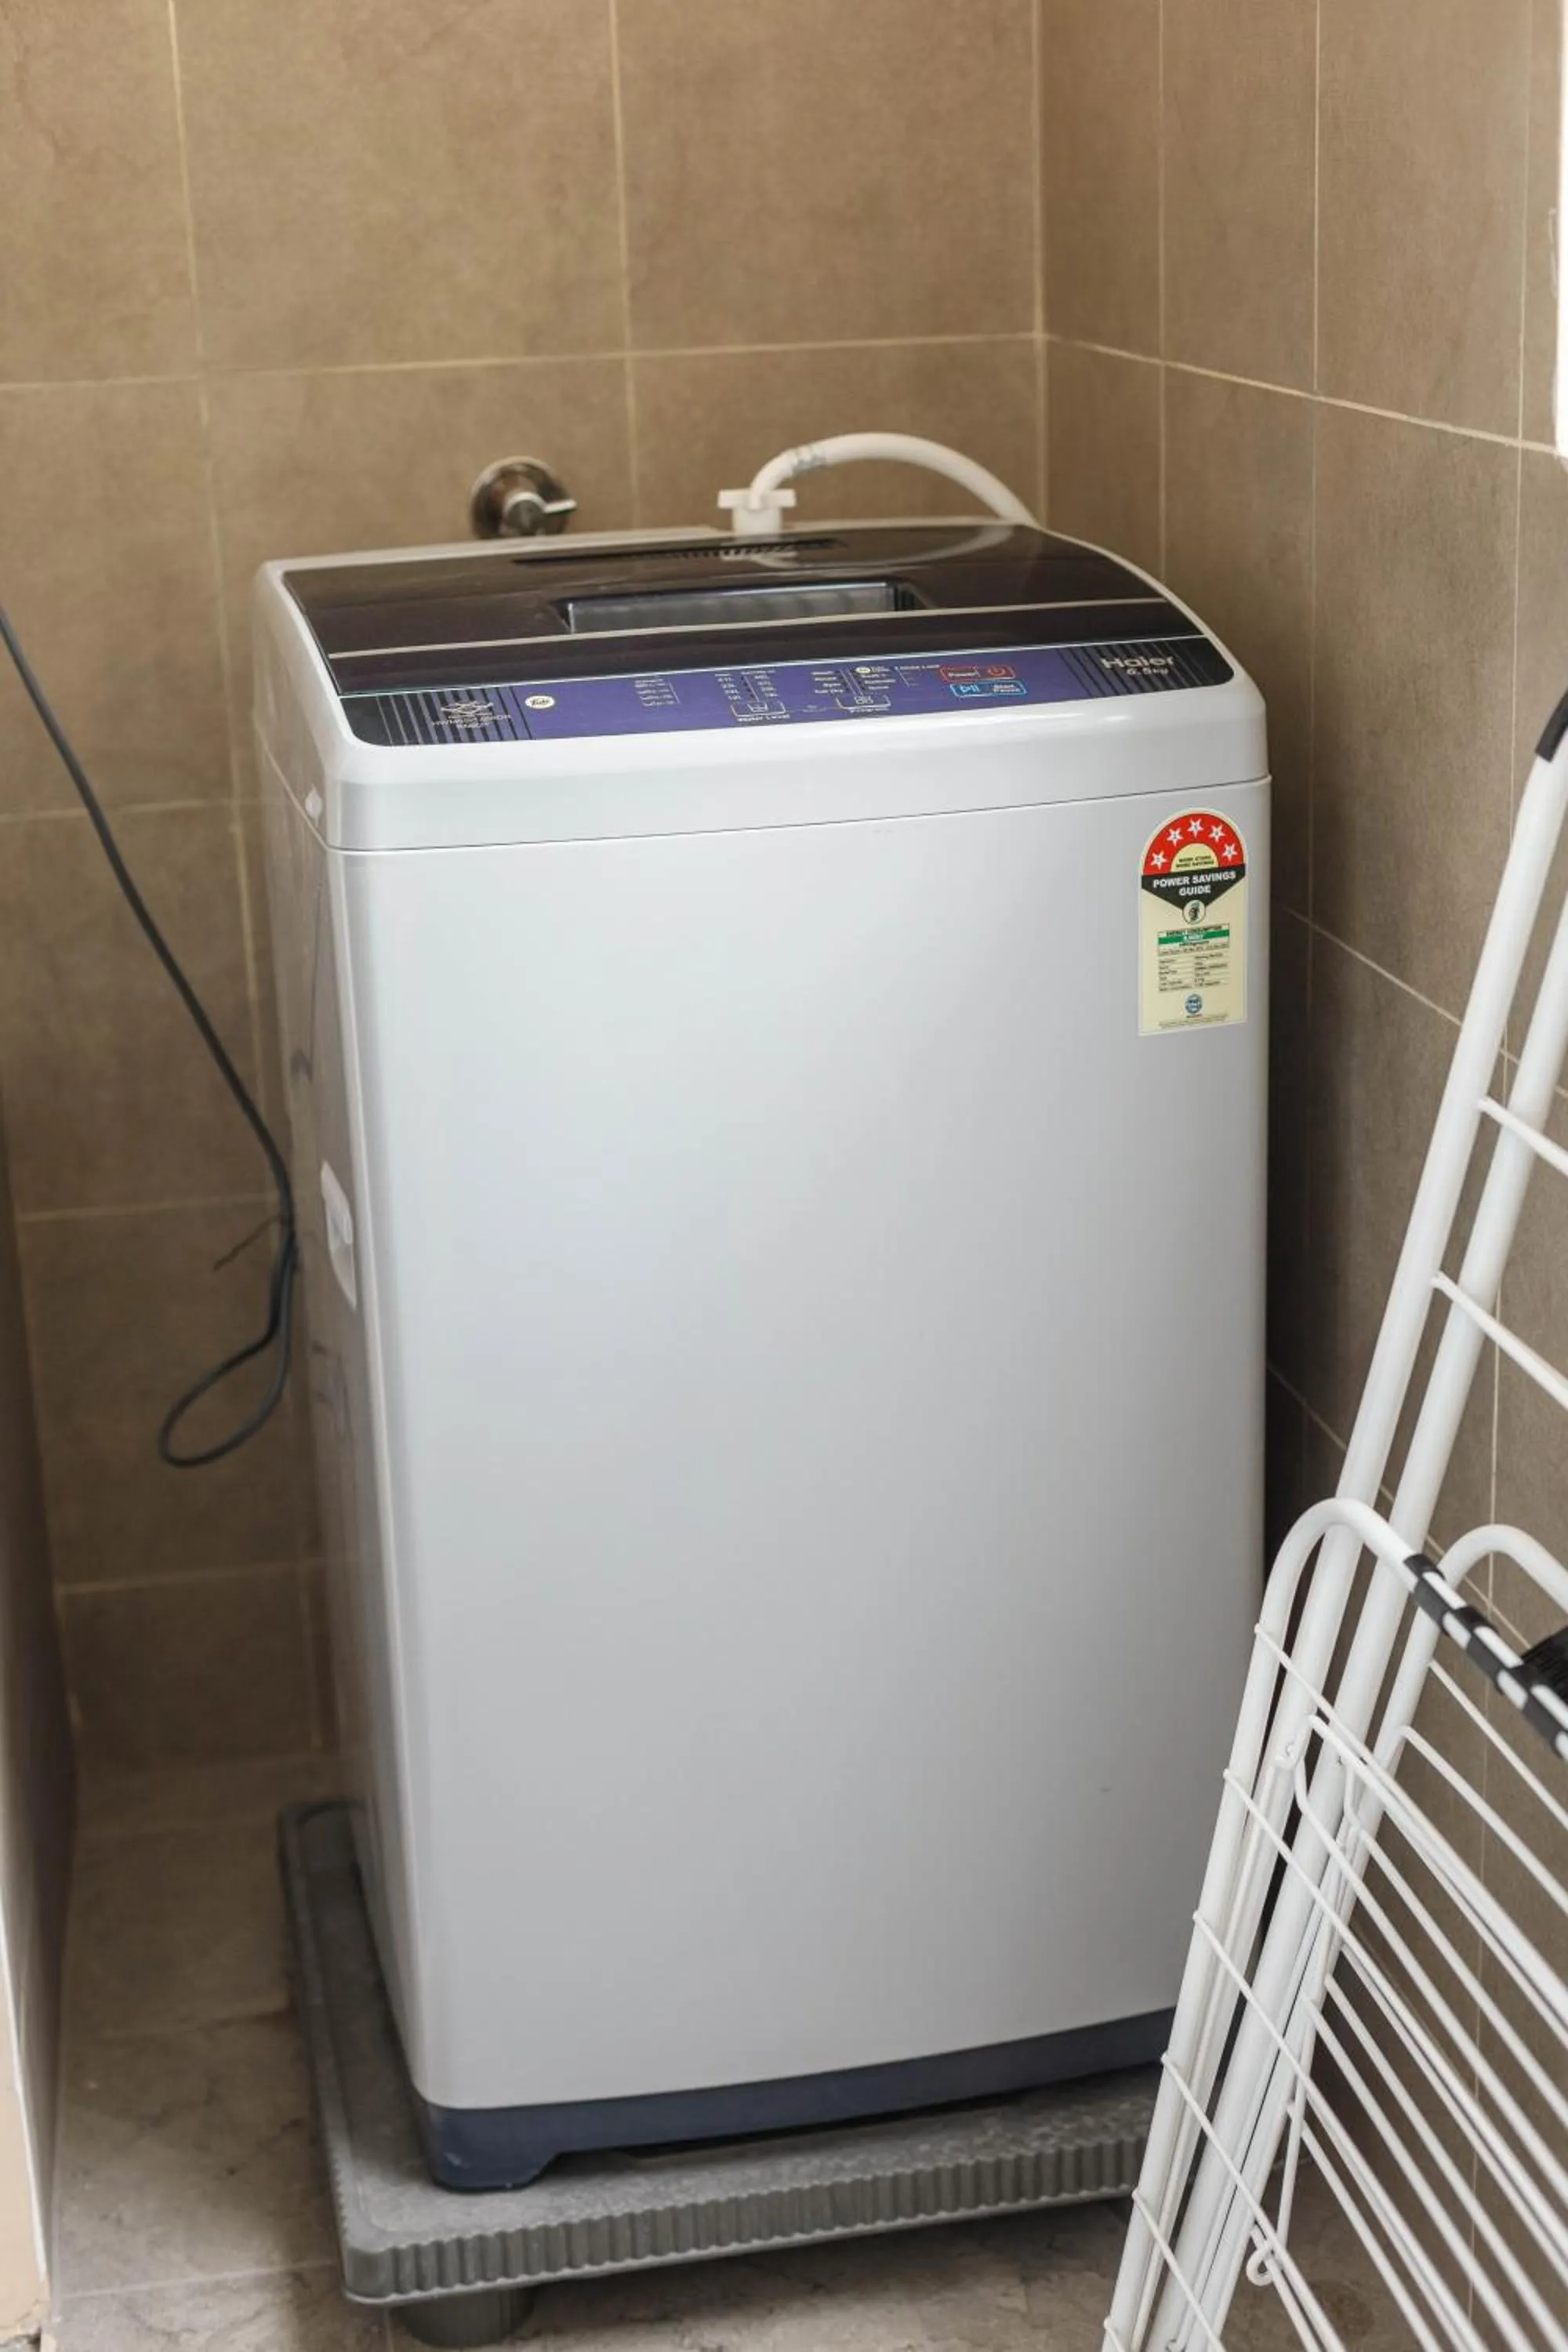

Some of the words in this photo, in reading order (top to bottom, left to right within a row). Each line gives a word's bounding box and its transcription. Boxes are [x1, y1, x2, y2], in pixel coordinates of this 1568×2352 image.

[1100, 656, 1174, 669] Haier
[1153, 877, 1190, 888] POWER
[1192, 871, 1236, 884] SAVINGS
[1178, 884, 1211, 896] GUIDE
